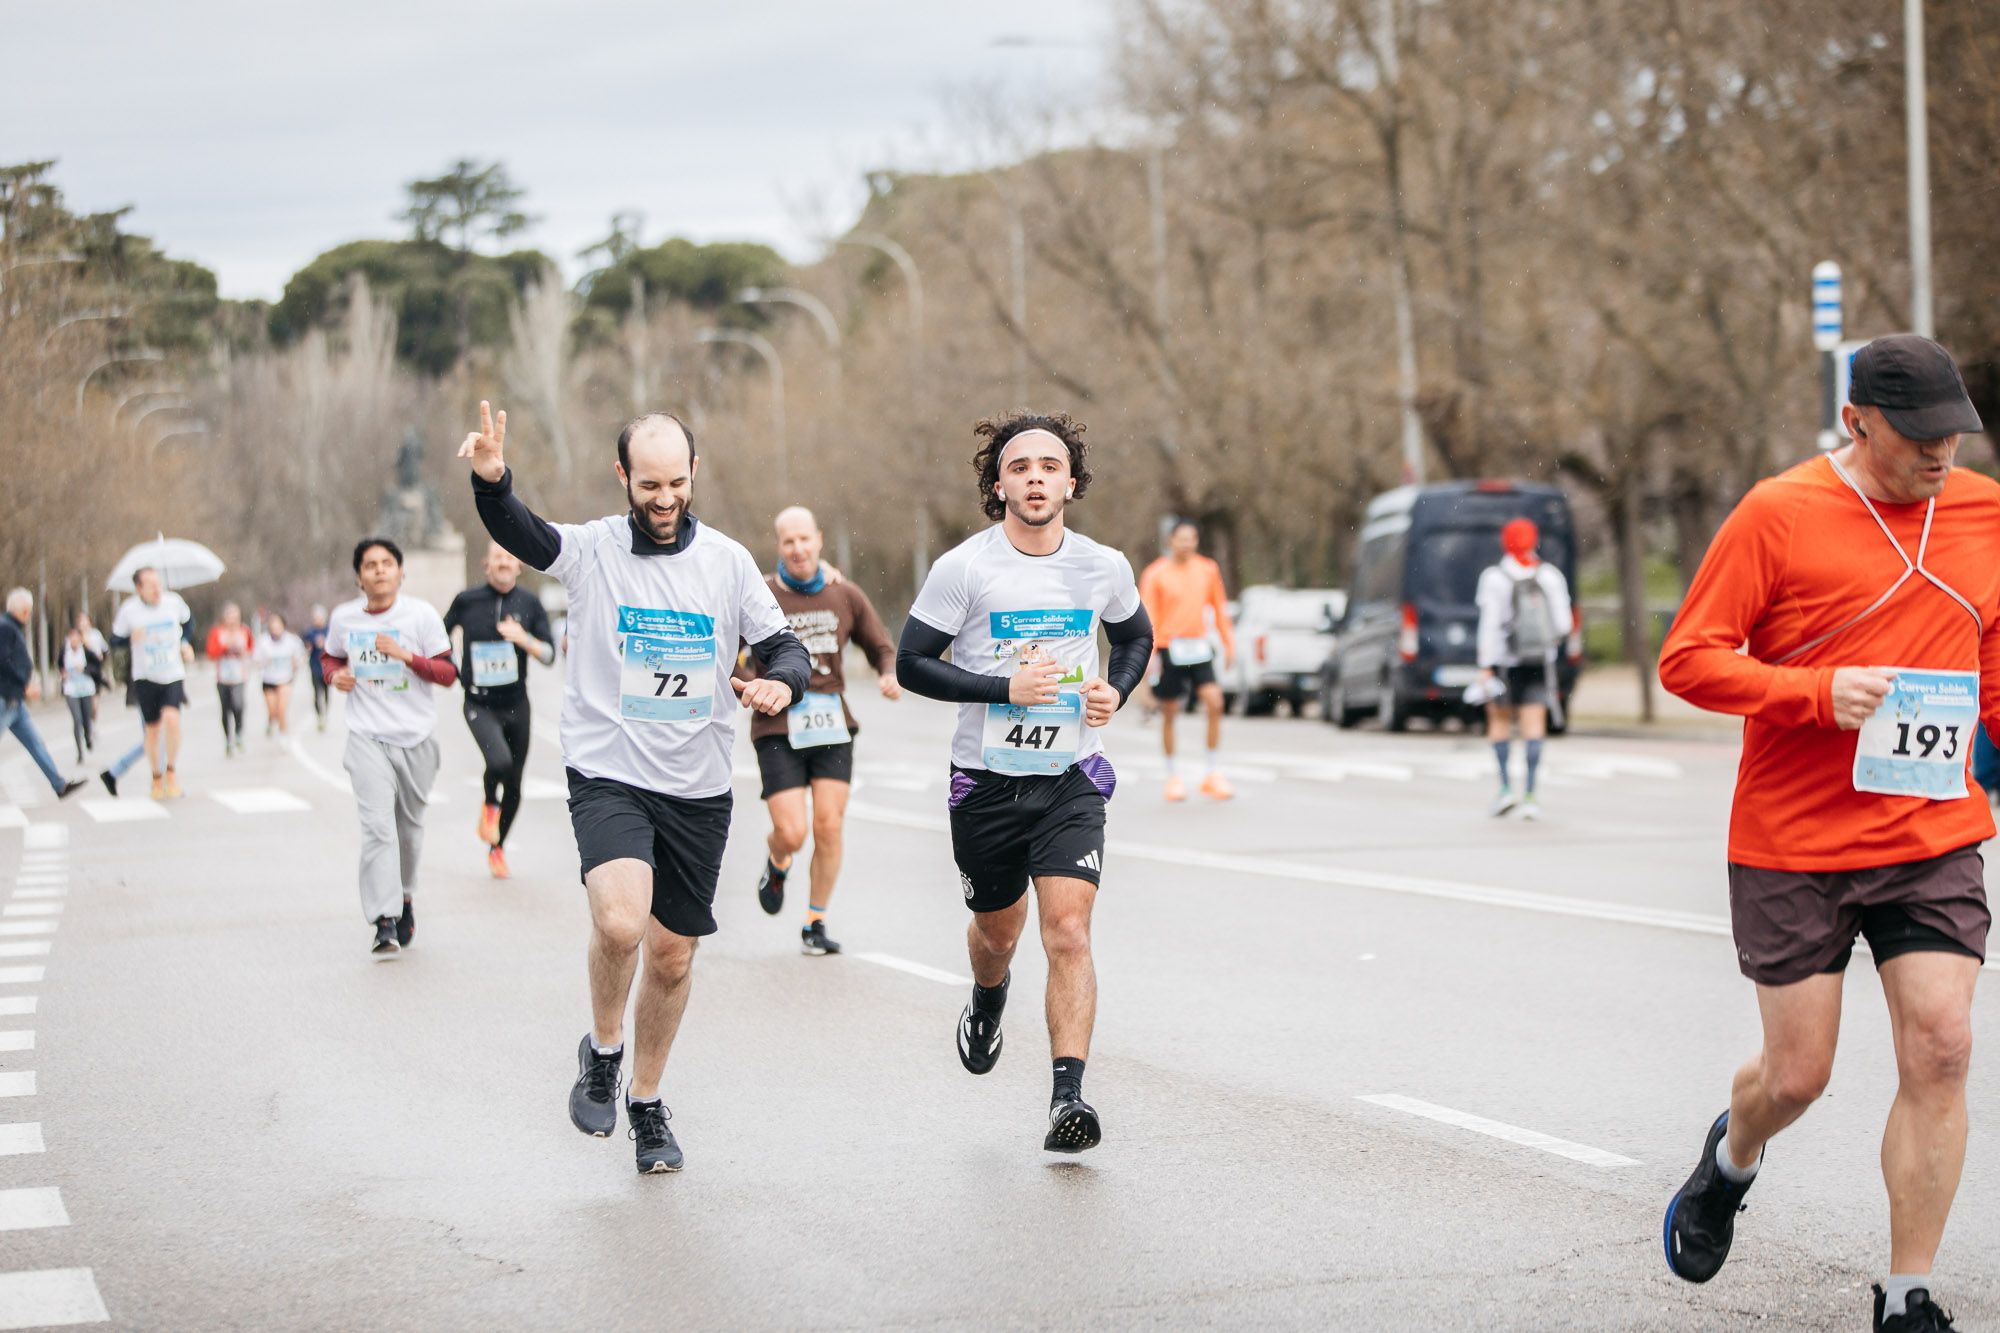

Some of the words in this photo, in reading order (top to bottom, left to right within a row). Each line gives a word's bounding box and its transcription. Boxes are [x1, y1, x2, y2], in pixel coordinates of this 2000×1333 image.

[1013, 616, 1041, 624] Carrera
[1042, 615, 1073, 623] Solidaria
[645, 643, 673, 653] Carrera
[674, 645, 705, 654] Solidaria
[653, 672, 688, 698] 72
[1898, 680, 1936, 694] Carrera
[802, 713, 834, 730] 205
[1004, 724, 1061, 750] 447
[1892, 722, 1959, 760] 193
